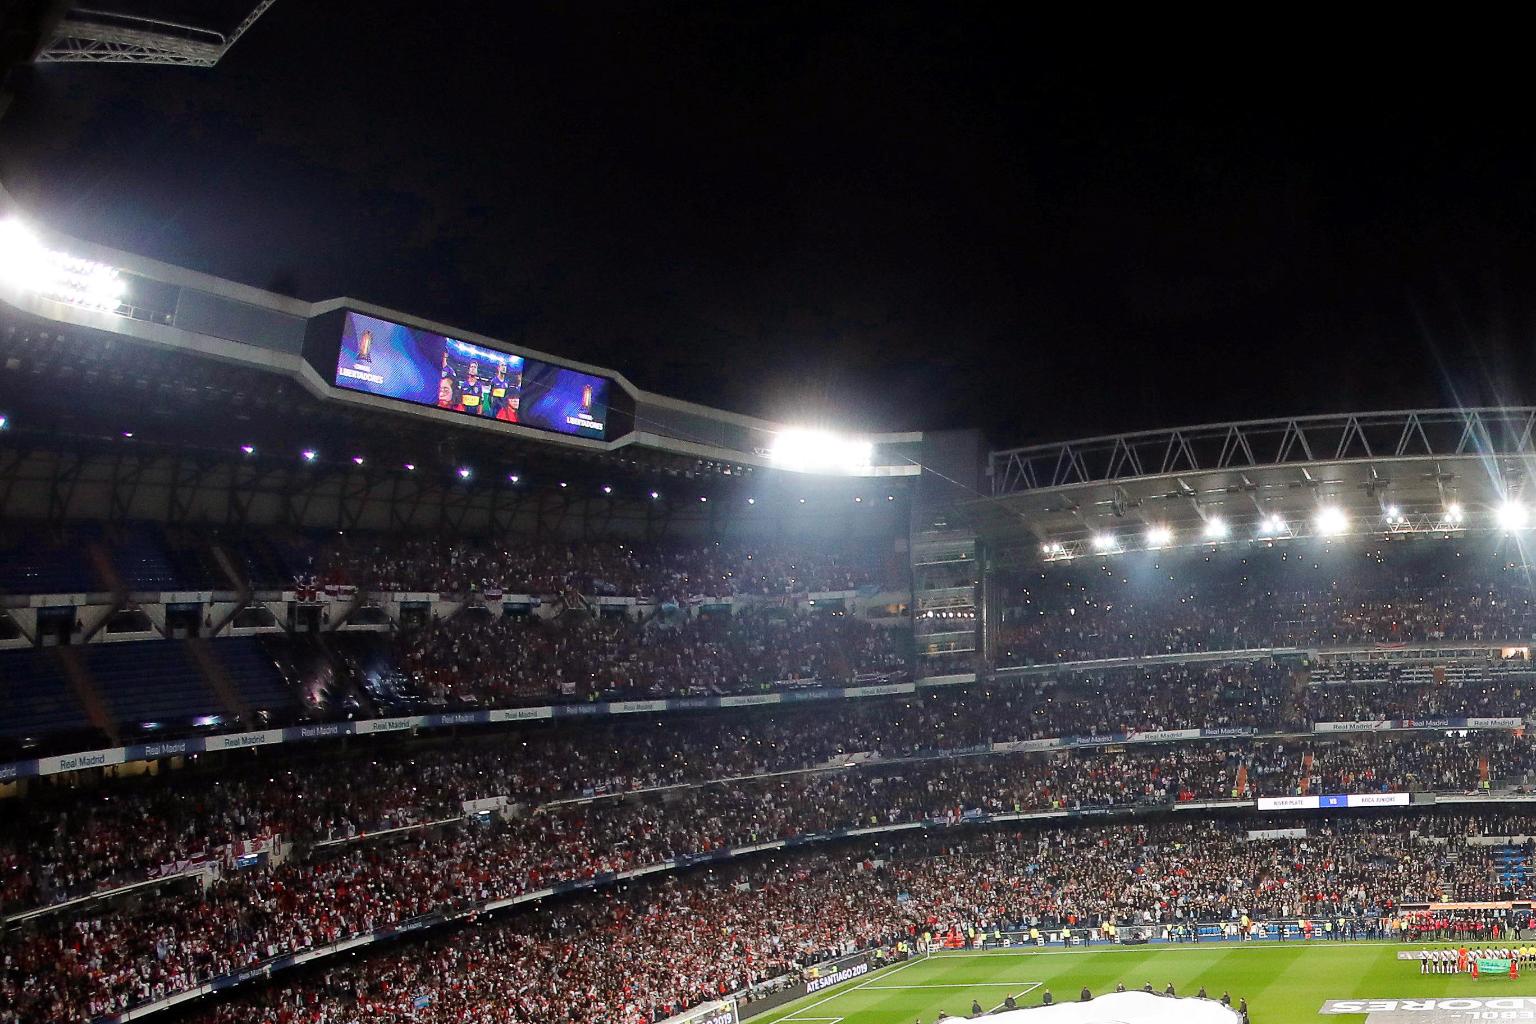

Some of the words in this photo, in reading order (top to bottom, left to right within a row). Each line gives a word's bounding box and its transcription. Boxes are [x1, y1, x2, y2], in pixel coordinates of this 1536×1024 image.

[301, 728, 315, 736] Real
[317, 725, 338, 735] Madrid
[373, 722, 387, 730] Real
[388, 720, 409, 729] Madrid
[225, 738, 240, 747] Real
[242, 734, 265, 745] Madrid
[145, 745, 161, 756] Real
[162, 743, 186, 753] Madrid
[60, 759, 77, 769] Real
[79, 754, 105, 766] Madrid
[820, 969, 852, 988] SANTIAGO
[852, 963, 868, 976] 2019
